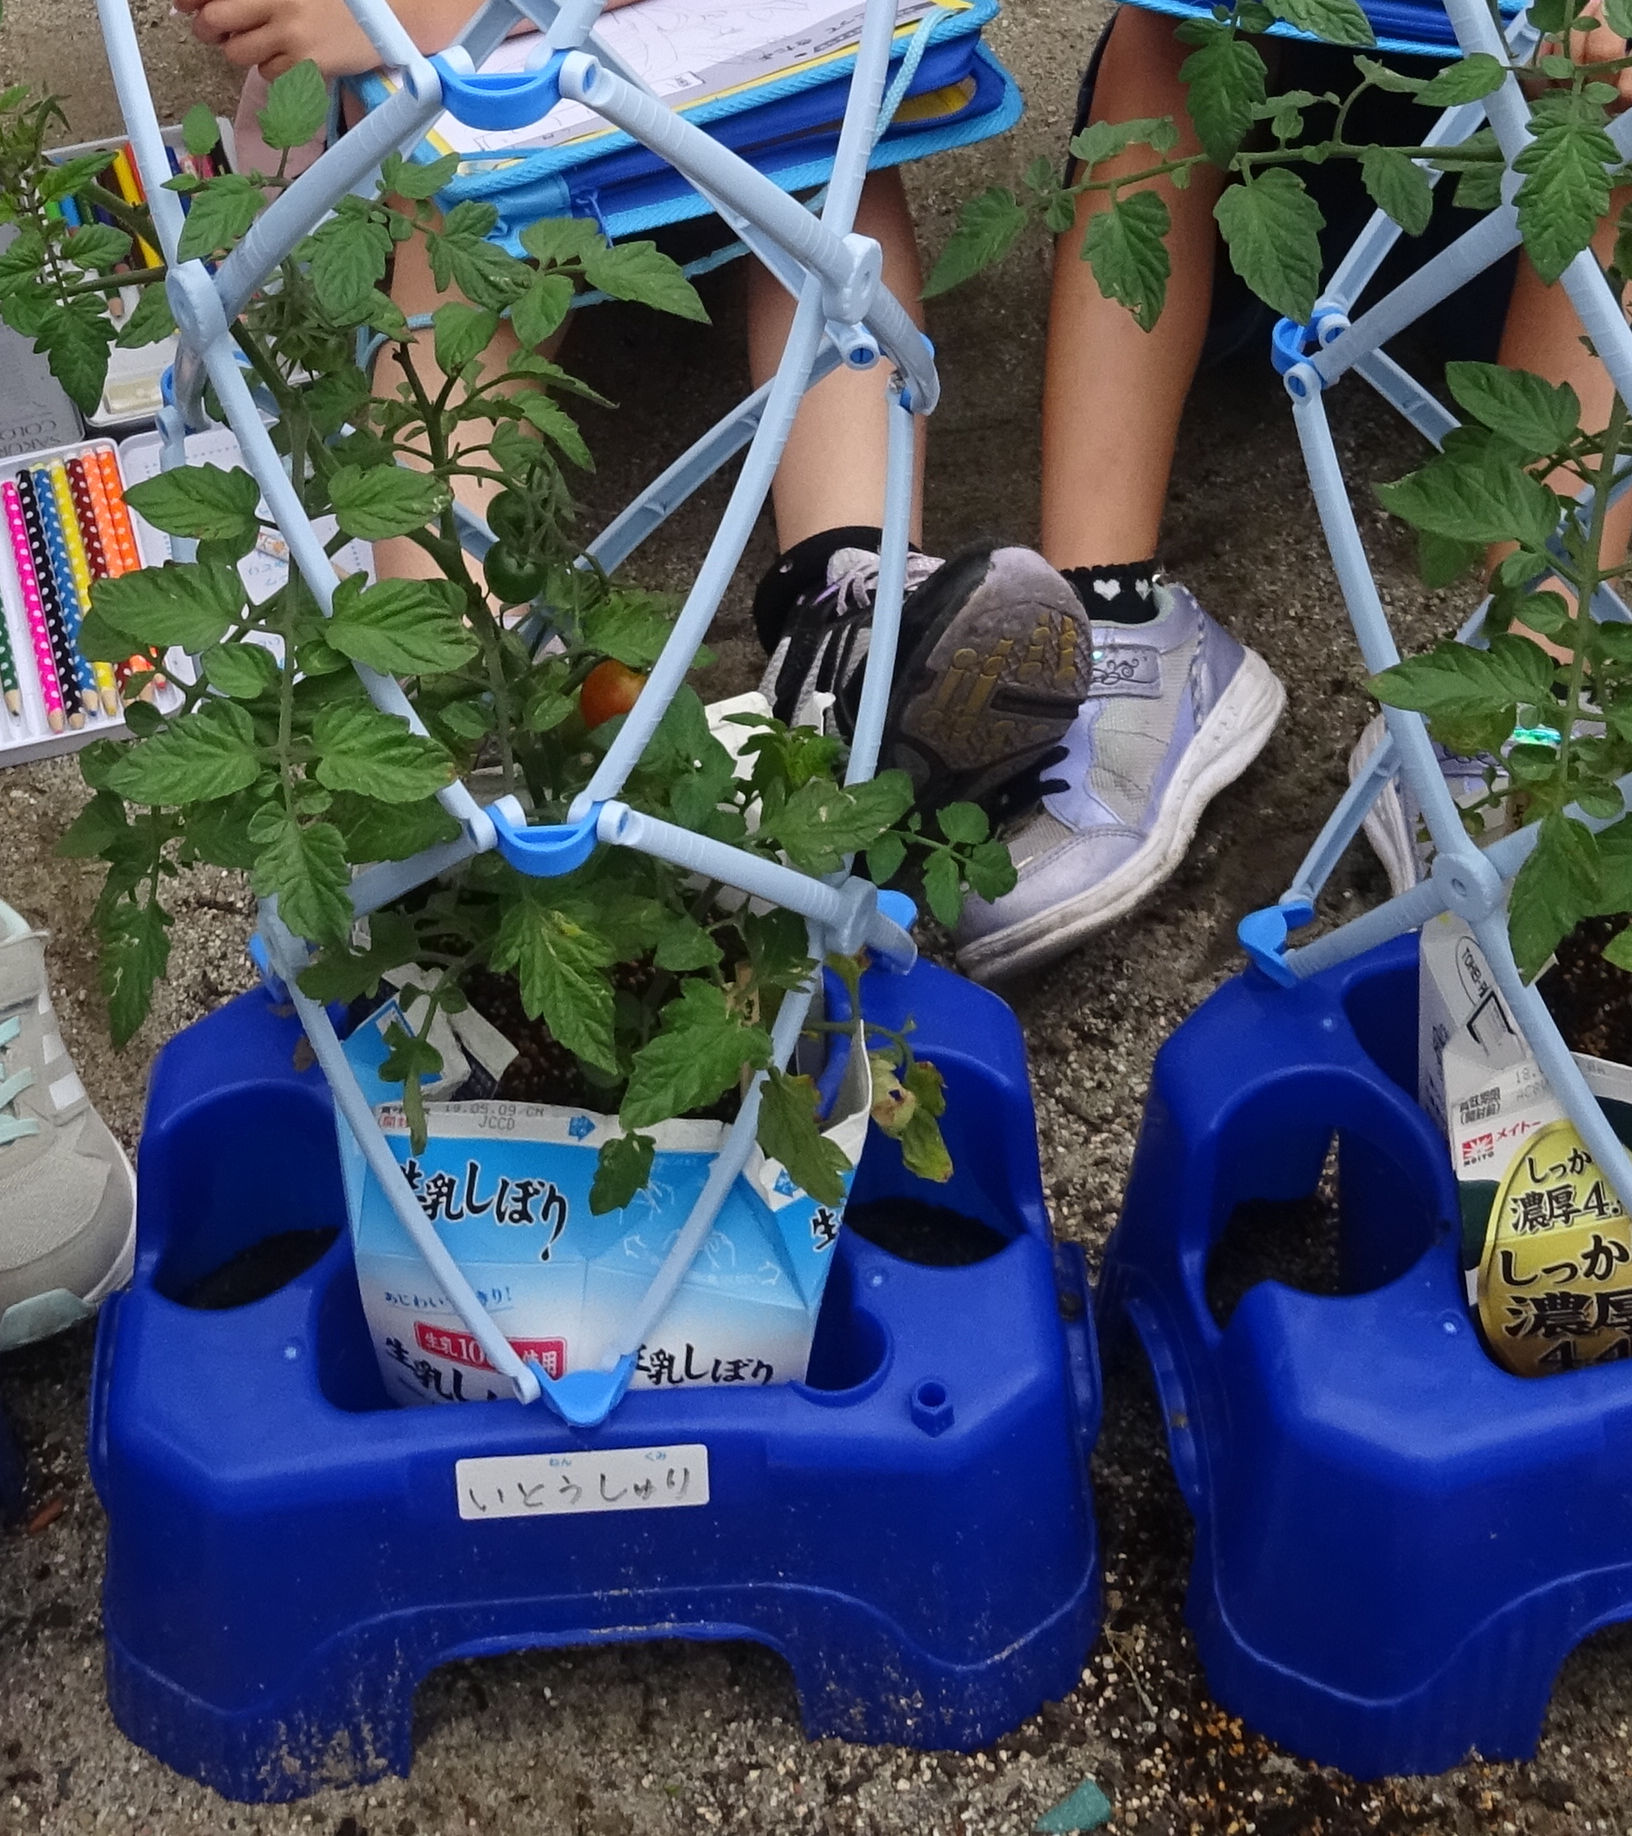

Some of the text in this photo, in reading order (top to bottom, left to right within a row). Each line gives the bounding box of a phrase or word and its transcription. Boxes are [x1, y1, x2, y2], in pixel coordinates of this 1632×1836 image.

[1496, 1120, 1542, 1143] メイトー
[424, 1331, 558, 1376] 生乳10使用
